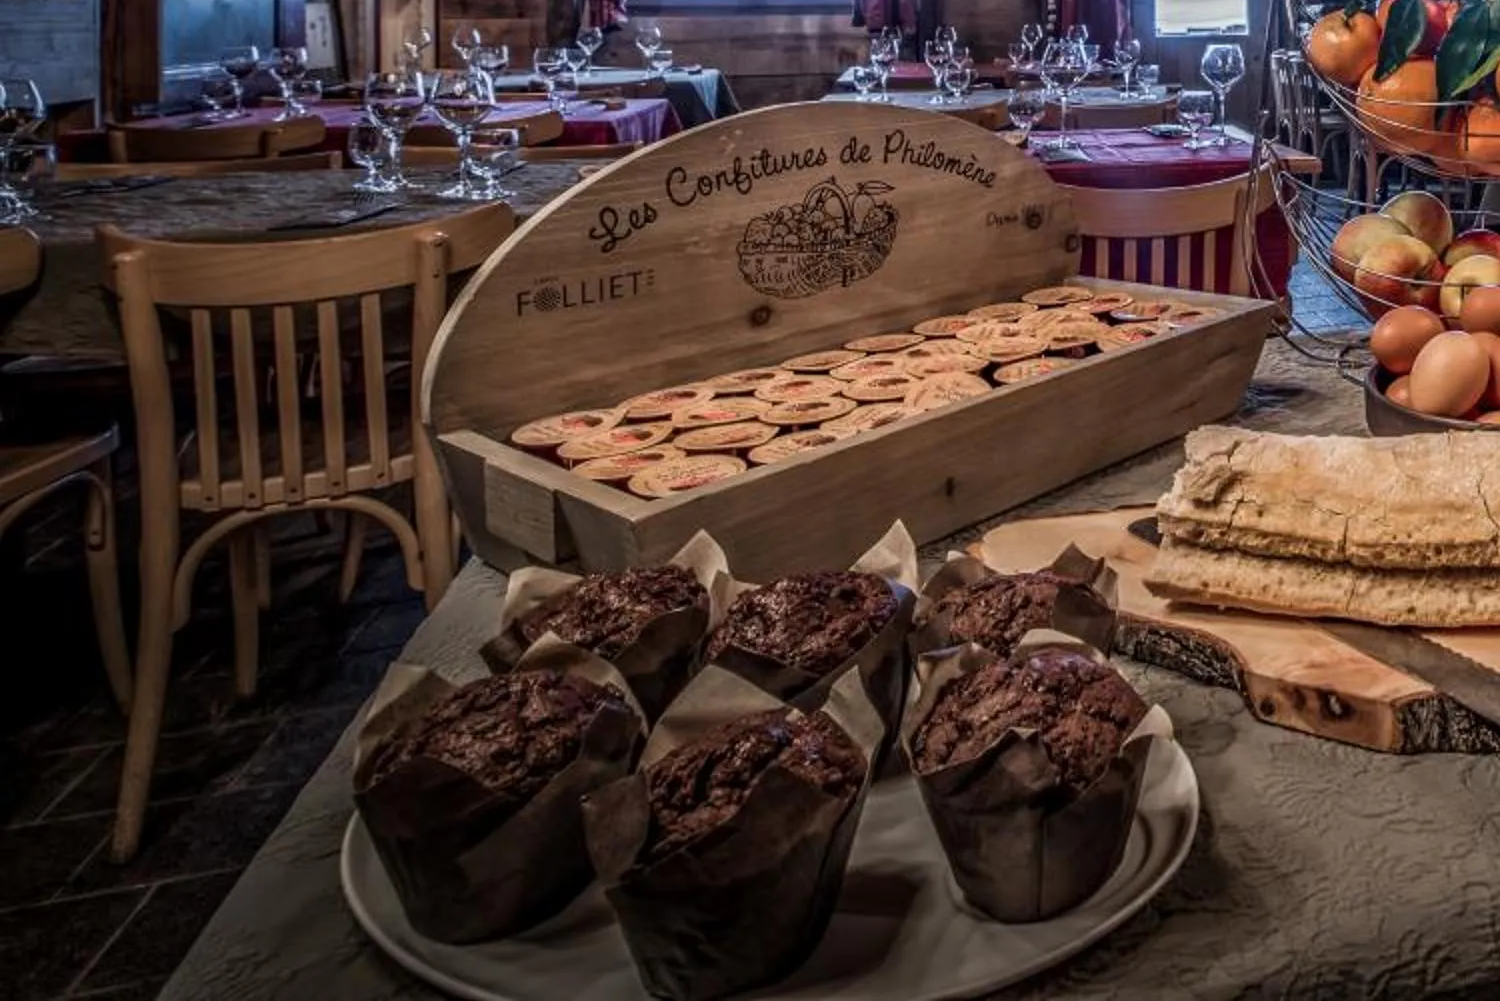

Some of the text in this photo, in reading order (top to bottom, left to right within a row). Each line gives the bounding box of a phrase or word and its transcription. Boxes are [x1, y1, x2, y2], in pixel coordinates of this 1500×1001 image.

[588, 128, 997, 254] Les Confitures de Philomène
